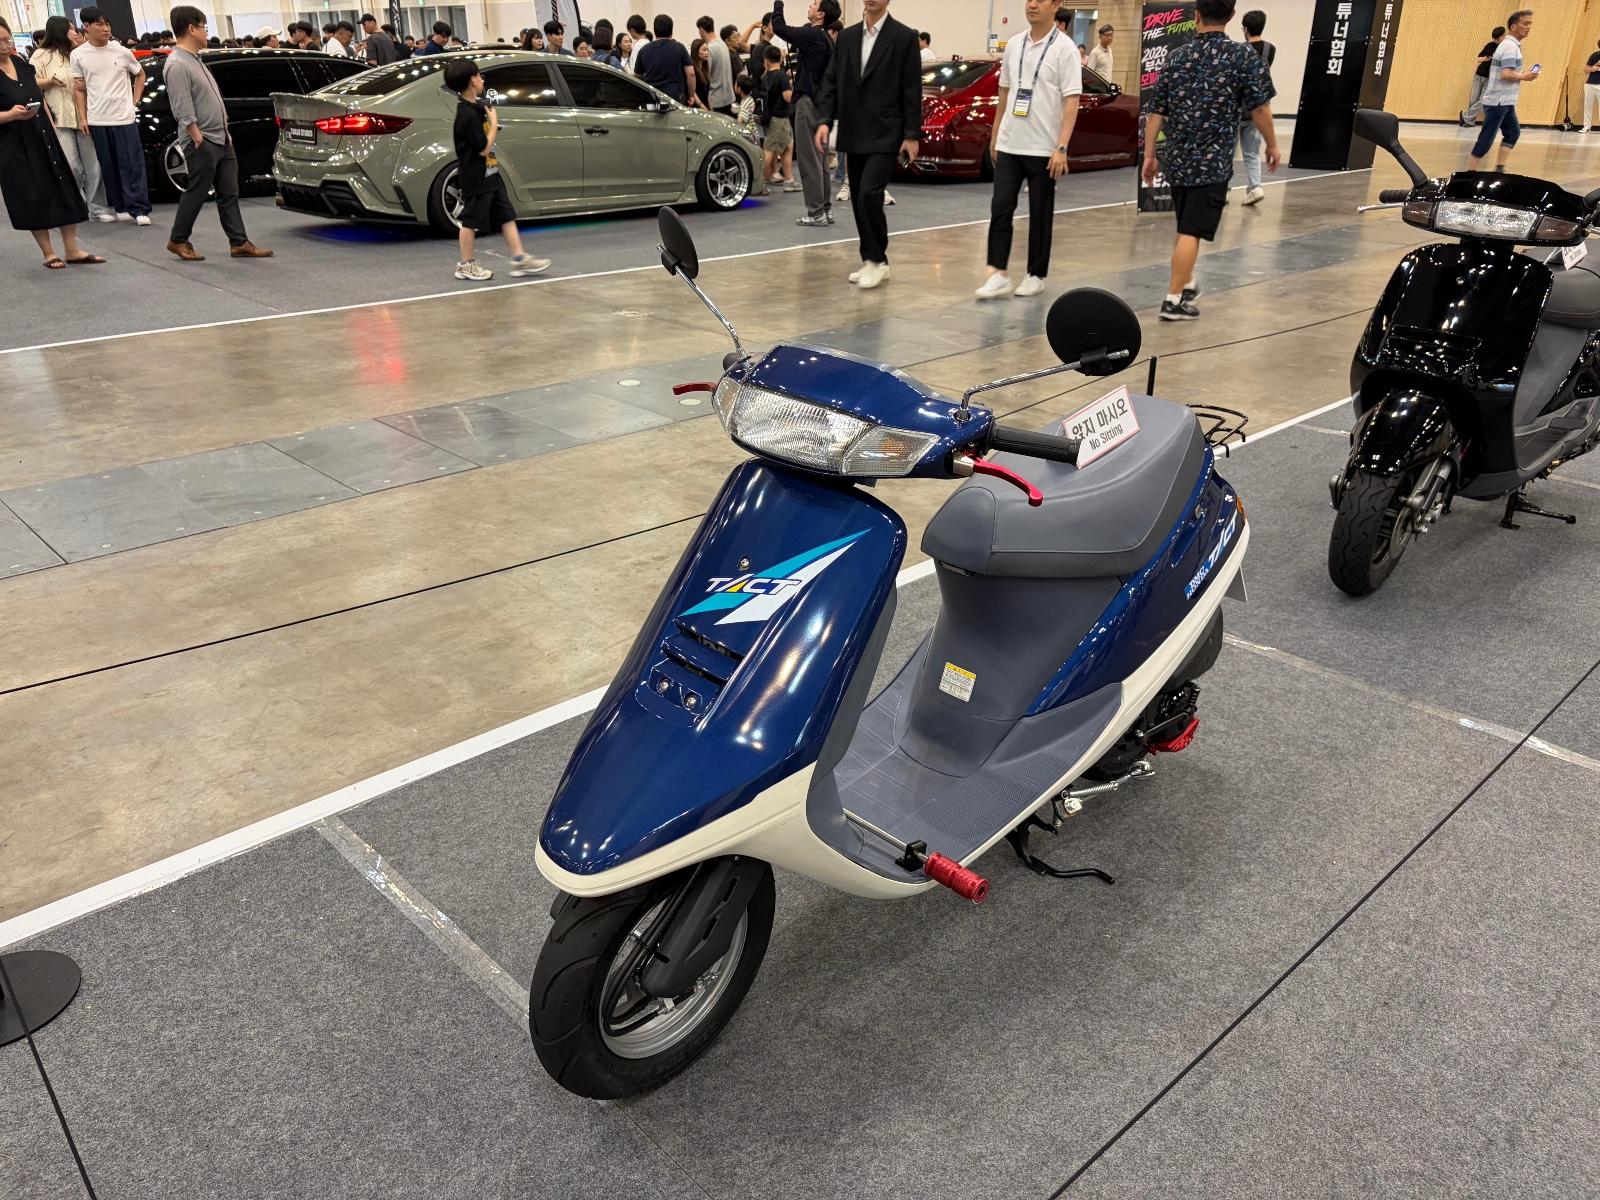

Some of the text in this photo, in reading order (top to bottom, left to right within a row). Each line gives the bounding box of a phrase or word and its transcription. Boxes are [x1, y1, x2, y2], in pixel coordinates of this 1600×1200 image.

[1142, 20, 1196, 41] THE FUTUR
[1143, 8, 1184, 31] DRIVE
[1141, 45, 1168, 64] 2026
[1095, 398, 1128, 428] 마시오
[1088, 423, 1124, 452] No Sitting
[704, 574, 802, 595] TACT
